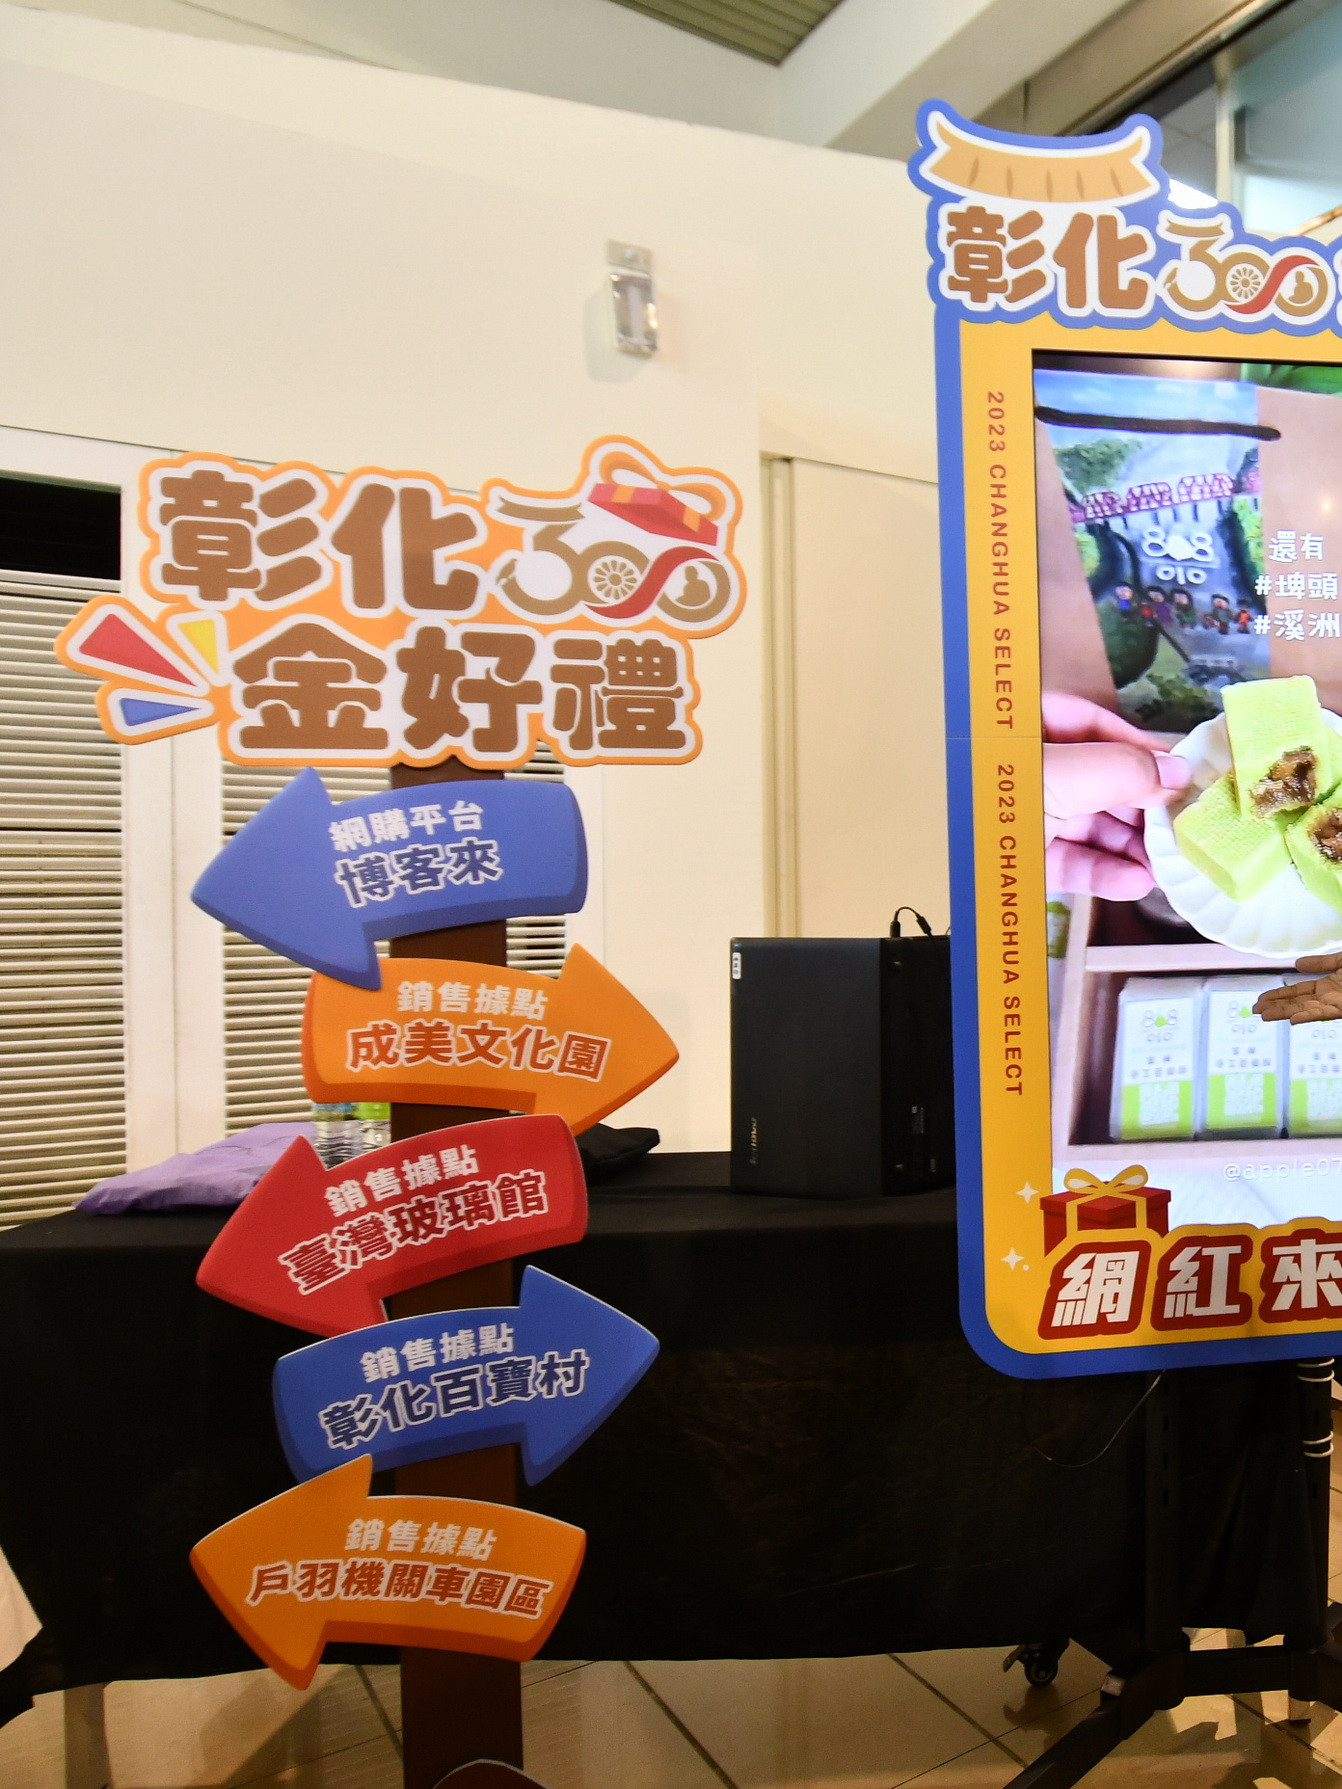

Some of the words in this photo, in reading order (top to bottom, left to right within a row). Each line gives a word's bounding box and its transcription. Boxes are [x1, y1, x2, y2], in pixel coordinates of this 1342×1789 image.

[987, 391, 1006, 454] 2023
[989, 463, 1011, 617] CHANGHUA
[1267, 529, 1325, 563] 還有
[1254, 571, 1339, 600] #埤頭
[1253, 608, 1342, 642] #溪洲
[231, 622, 687, 754] 金好禮
[992, 627, 1015, 731] SELECT
[996, 763, 1015, 825] 2023
[328, 800, 484, 852] 網購平台
[334, 837, 504, 908] 博客來
[999, 834, 1020, 985] CHANGHUA
[396, 979, 549, 1021] 銷售據點
[347, 1021, 612, 1082] 成美文化園
[1002, 995, 1024, 1098] SELECT
[324, 1144, 479, 1218] 銷售據點
[278, 1169, 549, 1296] 臺灣玻璃館
[361, 1322, 515, 1384] 銷售據點
[319, 1348, 590, 1453] 彰化百寶村
[344, 1517, 498, 1562] 銷售據點
